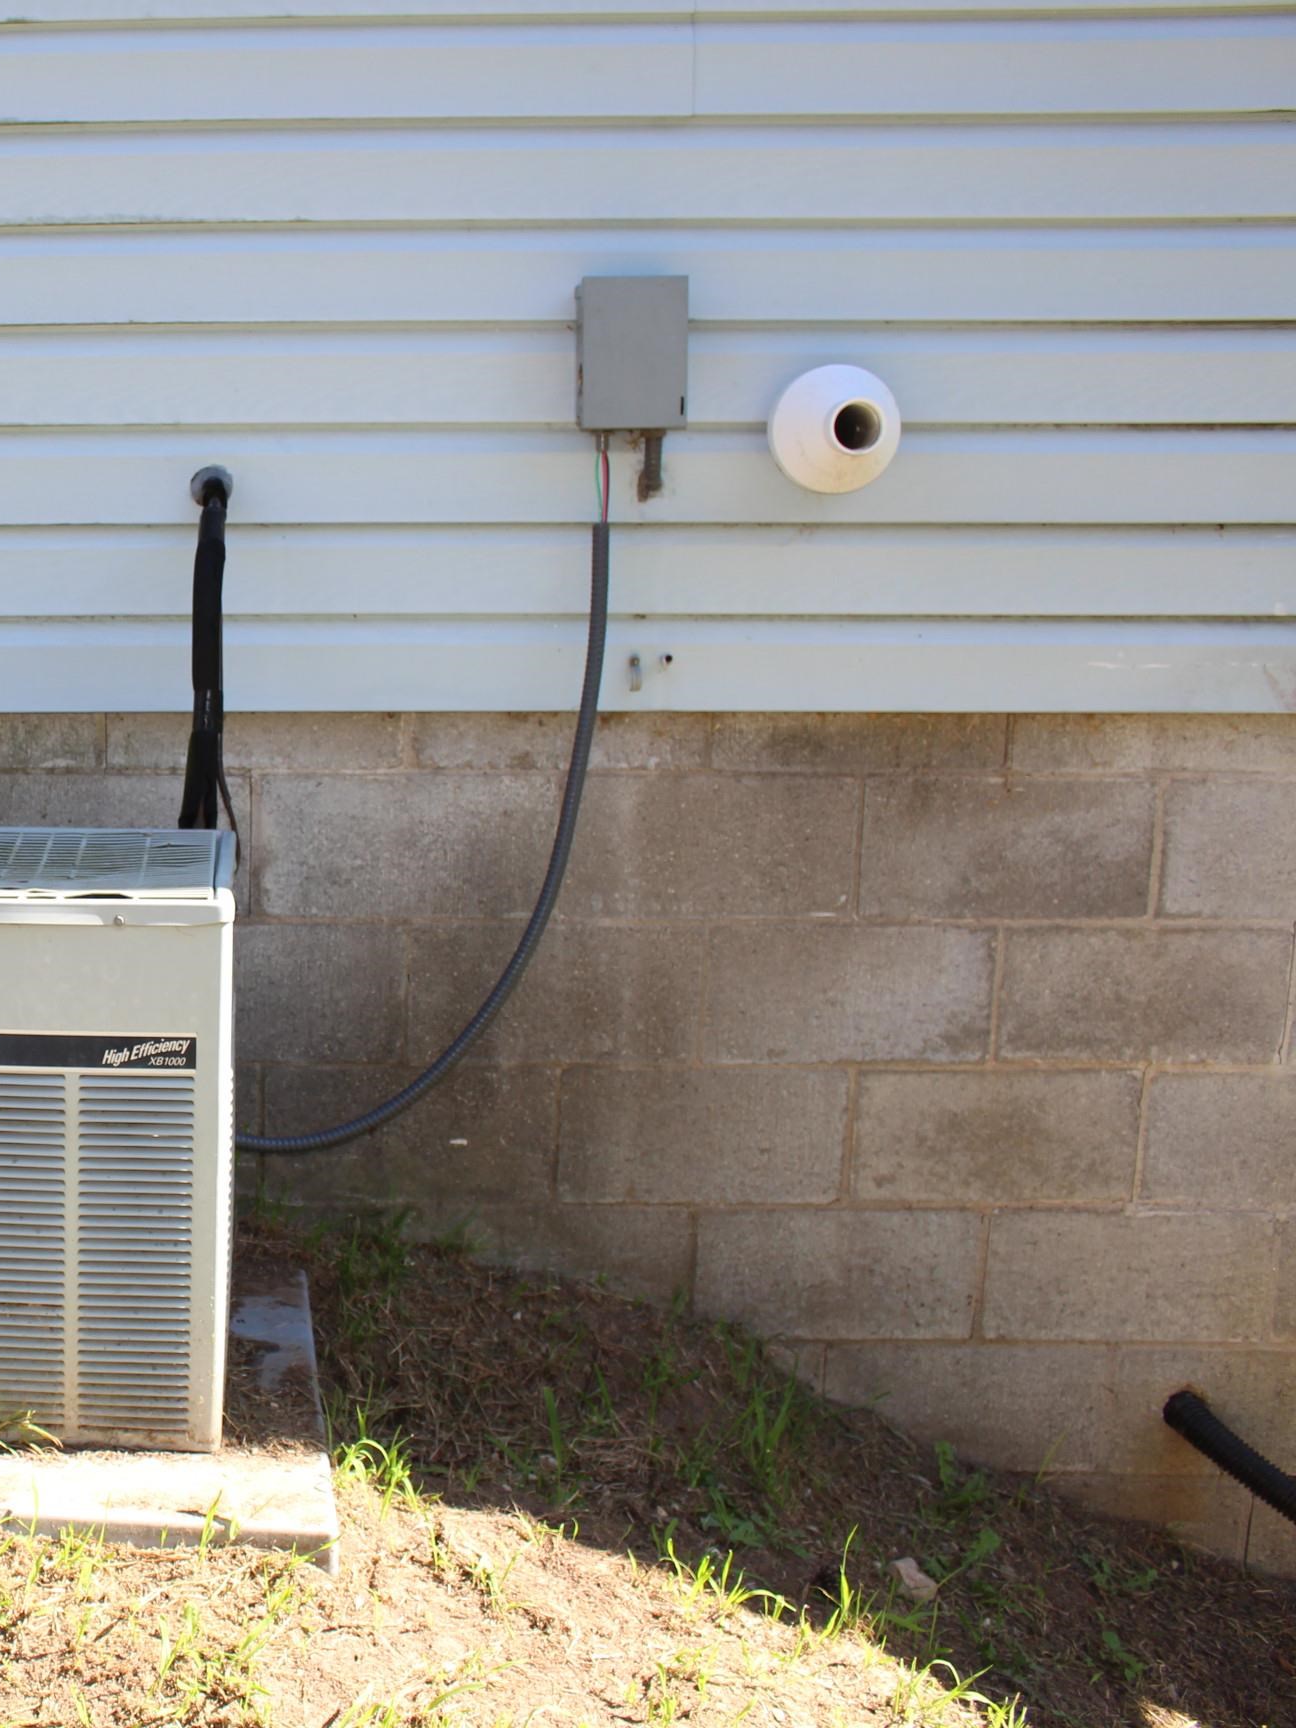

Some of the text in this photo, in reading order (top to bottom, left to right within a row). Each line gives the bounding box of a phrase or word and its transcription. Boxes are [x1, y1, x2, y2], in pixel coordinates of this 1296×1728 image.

[102, 1038, 191, 1067] High Efficiency
[148, 1056, 187, 1066] XB1000
